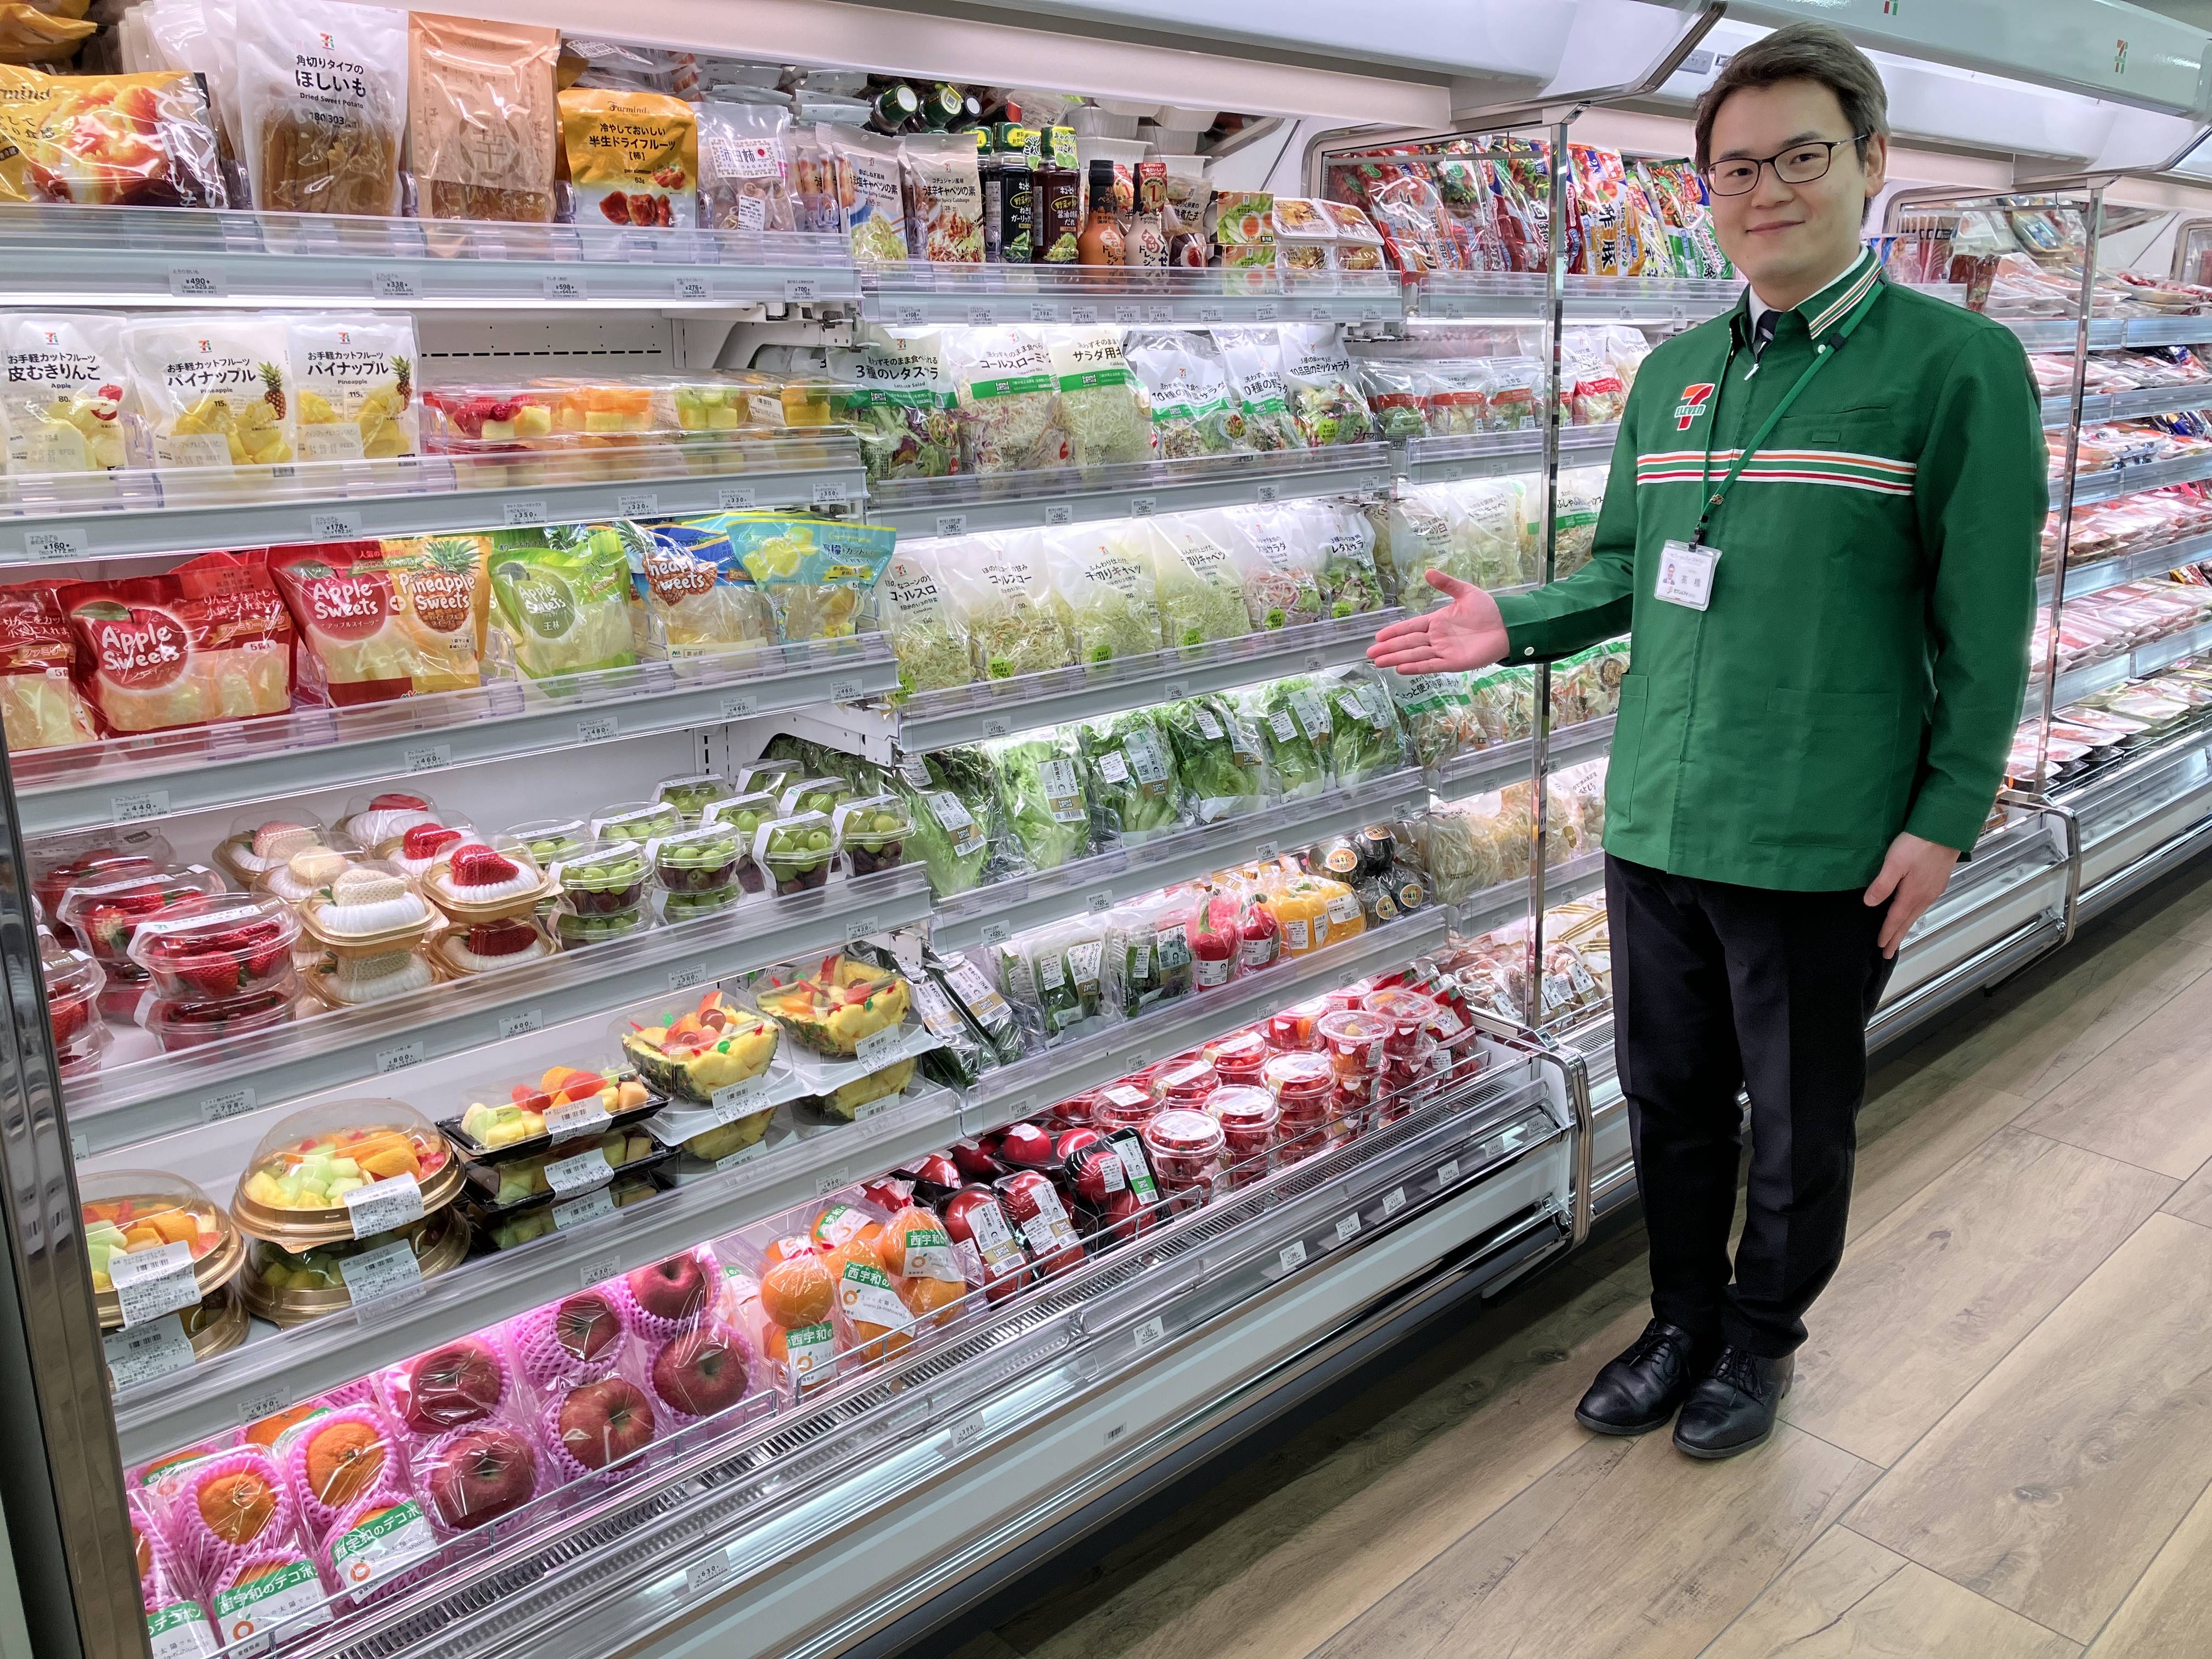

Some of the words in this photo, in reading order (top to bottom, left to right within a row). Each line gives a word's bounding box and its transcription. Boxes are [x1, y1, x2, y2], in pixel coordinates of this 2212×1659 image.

[296, 54, 364, 75] 角切りタイプの
[295, 69, 366, 98] ほしいも
[300, 93, 319, 101] Dried
[320, 96, 341, 105] Sweet
[342, 100, 363, 109] Potato
[607, 100, 647, 114] Farmind
[600, 123, 666, 136] 冷やしておいしい
[589, 135, 676, 151] 半生ドライフルーツ
[7, 352, 96, 364] お手軽カットフルーツ
[307, 351, 384, 360] お手軽カットフルーツ
[8, 363, 101, 382] 皮むきりんご
[167, 358, 250, 373] お手軽カットフルーツ
[307, 361, 389, 375] パイナップル
[167, 369, 256, 387] パイナップル
[1181, 552, 1226, 566] 切りキャベツ
[312, 578, 373, 604] Apple
[398, 572, 476, 594] Pineapple
[313, 599, 379, 620] Sweets
[415, 591, 471, 611] Sweets
[543, 619, 560, 631] 王林
[101, 623, 172, 652] Apple
[101, 645, 180, 672] Sweets
